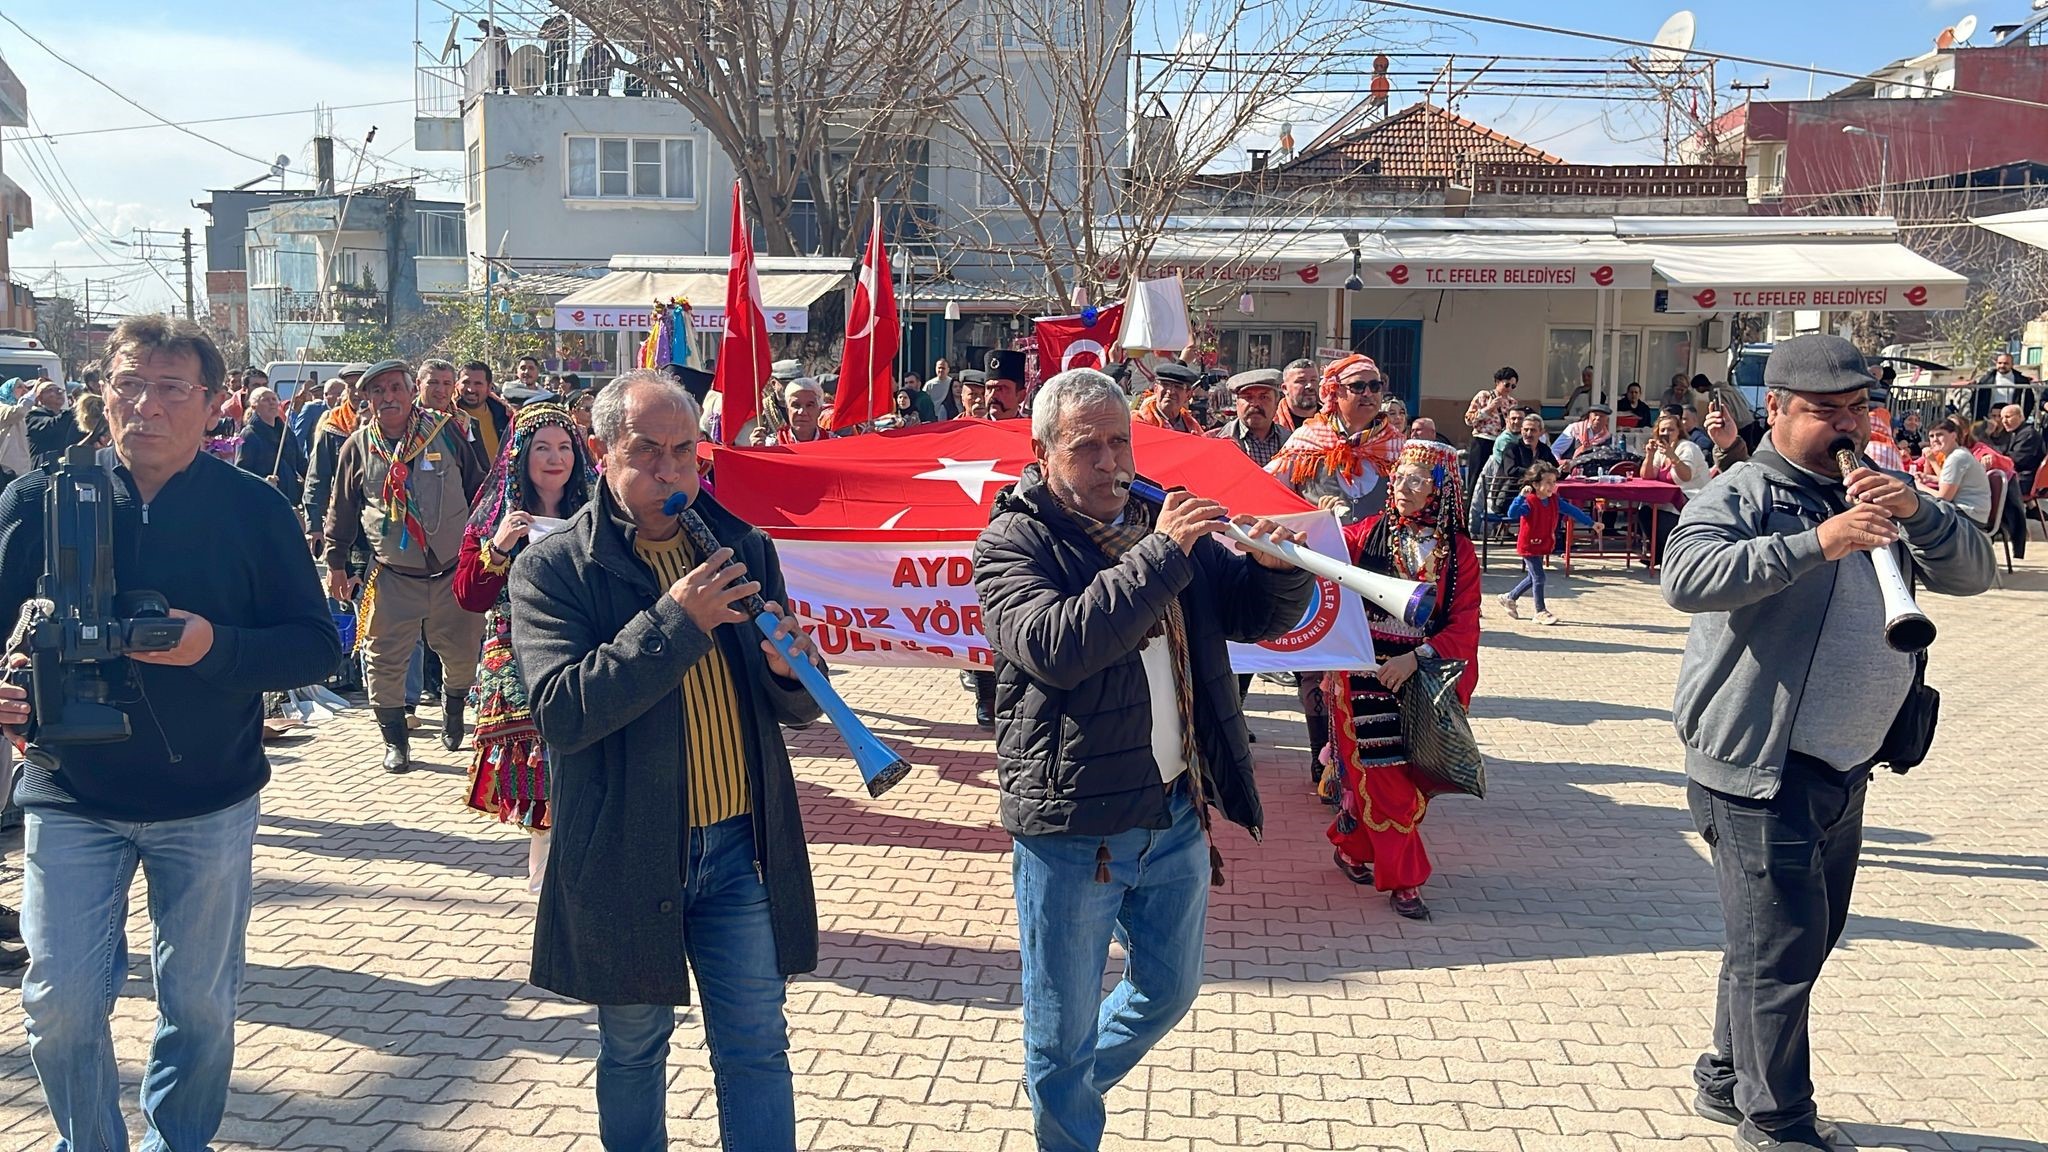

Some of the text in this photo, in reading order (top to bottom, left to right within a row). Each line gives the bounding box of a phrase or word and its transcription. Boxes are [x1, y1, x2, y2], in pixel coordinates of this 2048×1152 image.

[1425, 266, 1576, 284] T.C. EFELER BELEDİYESİ
[1733, 287, 1887, 306] T.C. EFELER BELEDİYESİ
[593, 313, 614, 327] T.C.
[892, 556, 974, 588] AYD
[1322, 580, 1335, 610] ELER
[788, 598, 986, 636] ILDIZ YÖR
